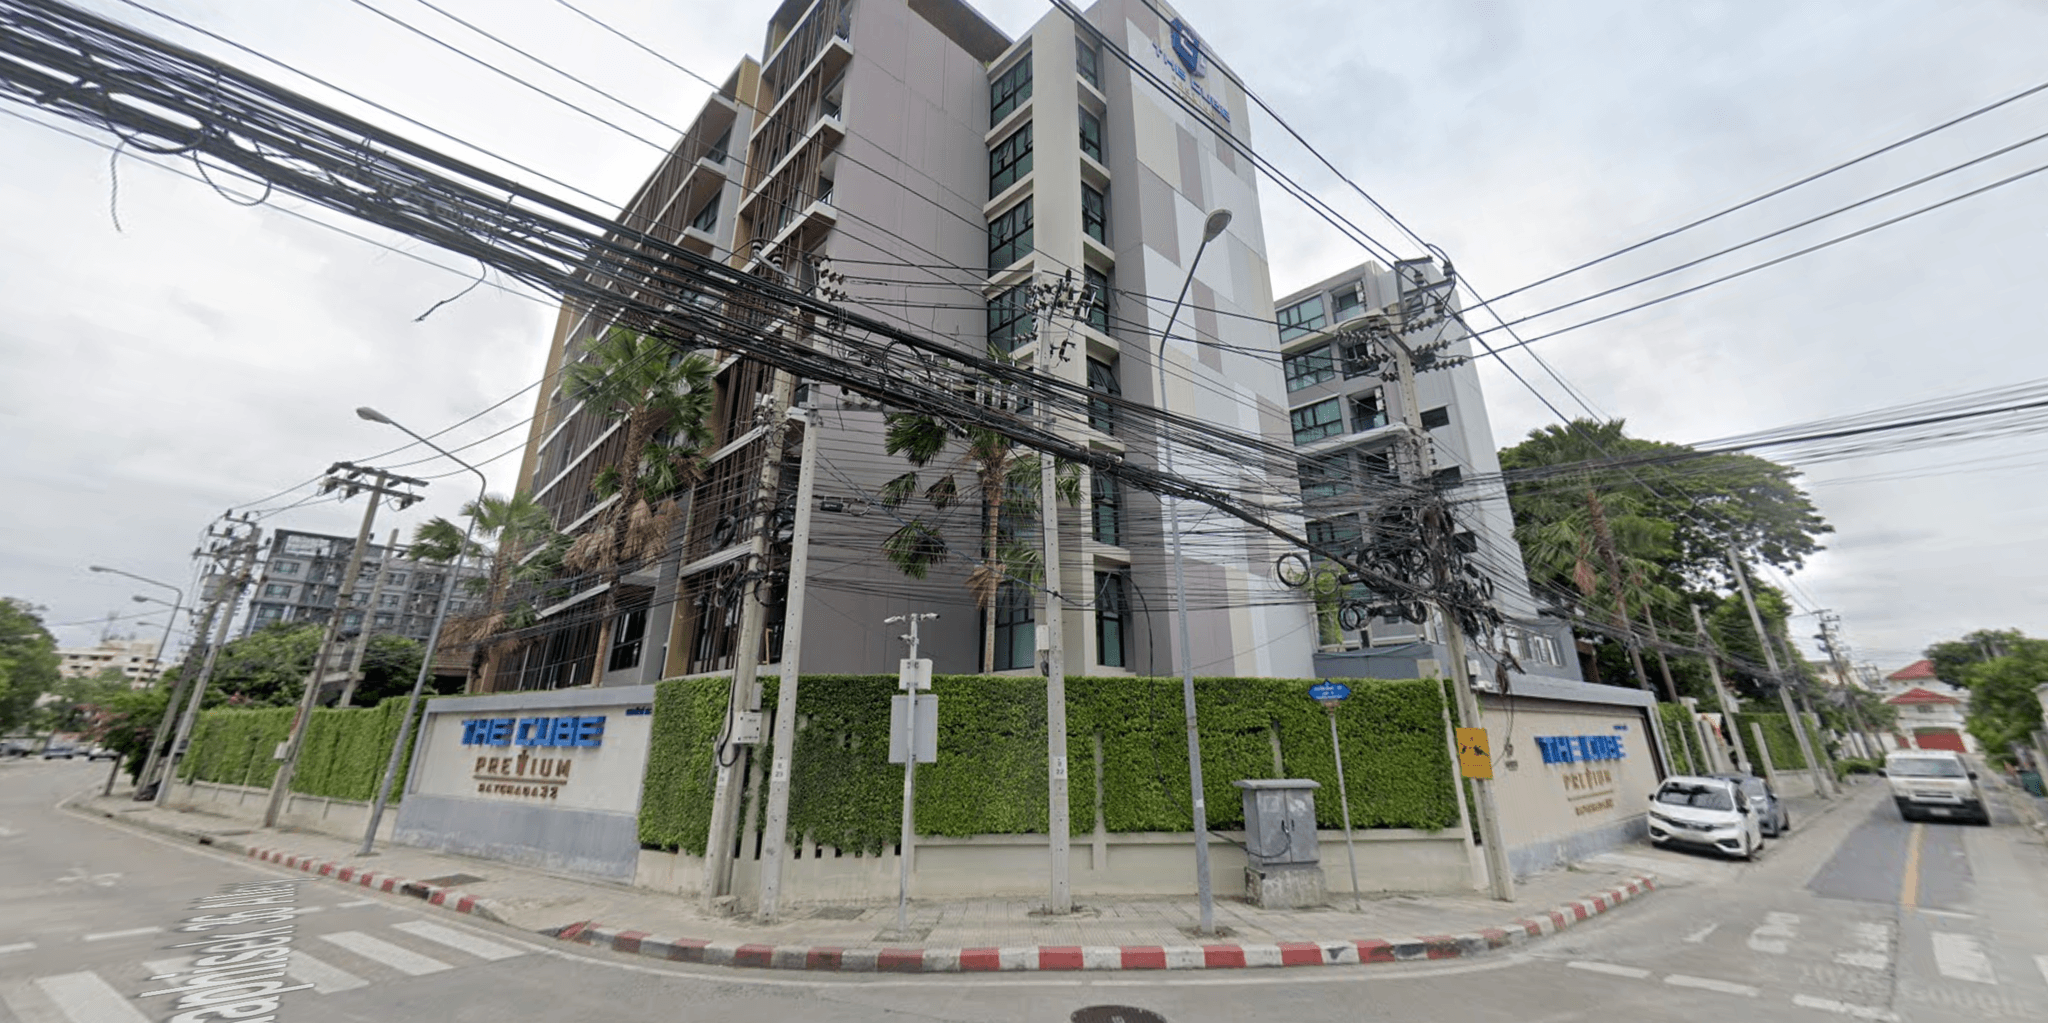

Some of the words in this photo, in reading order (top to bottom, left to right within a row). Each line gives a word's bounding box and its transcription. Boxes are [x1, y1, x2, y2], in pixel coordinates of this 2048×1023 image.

[461, 718, 516, 745] THE
[515, 716, 606, 747] CUBE
[1534, 735, 1583, 764] THE
[1581, 734, 1627, 761] CUBE
